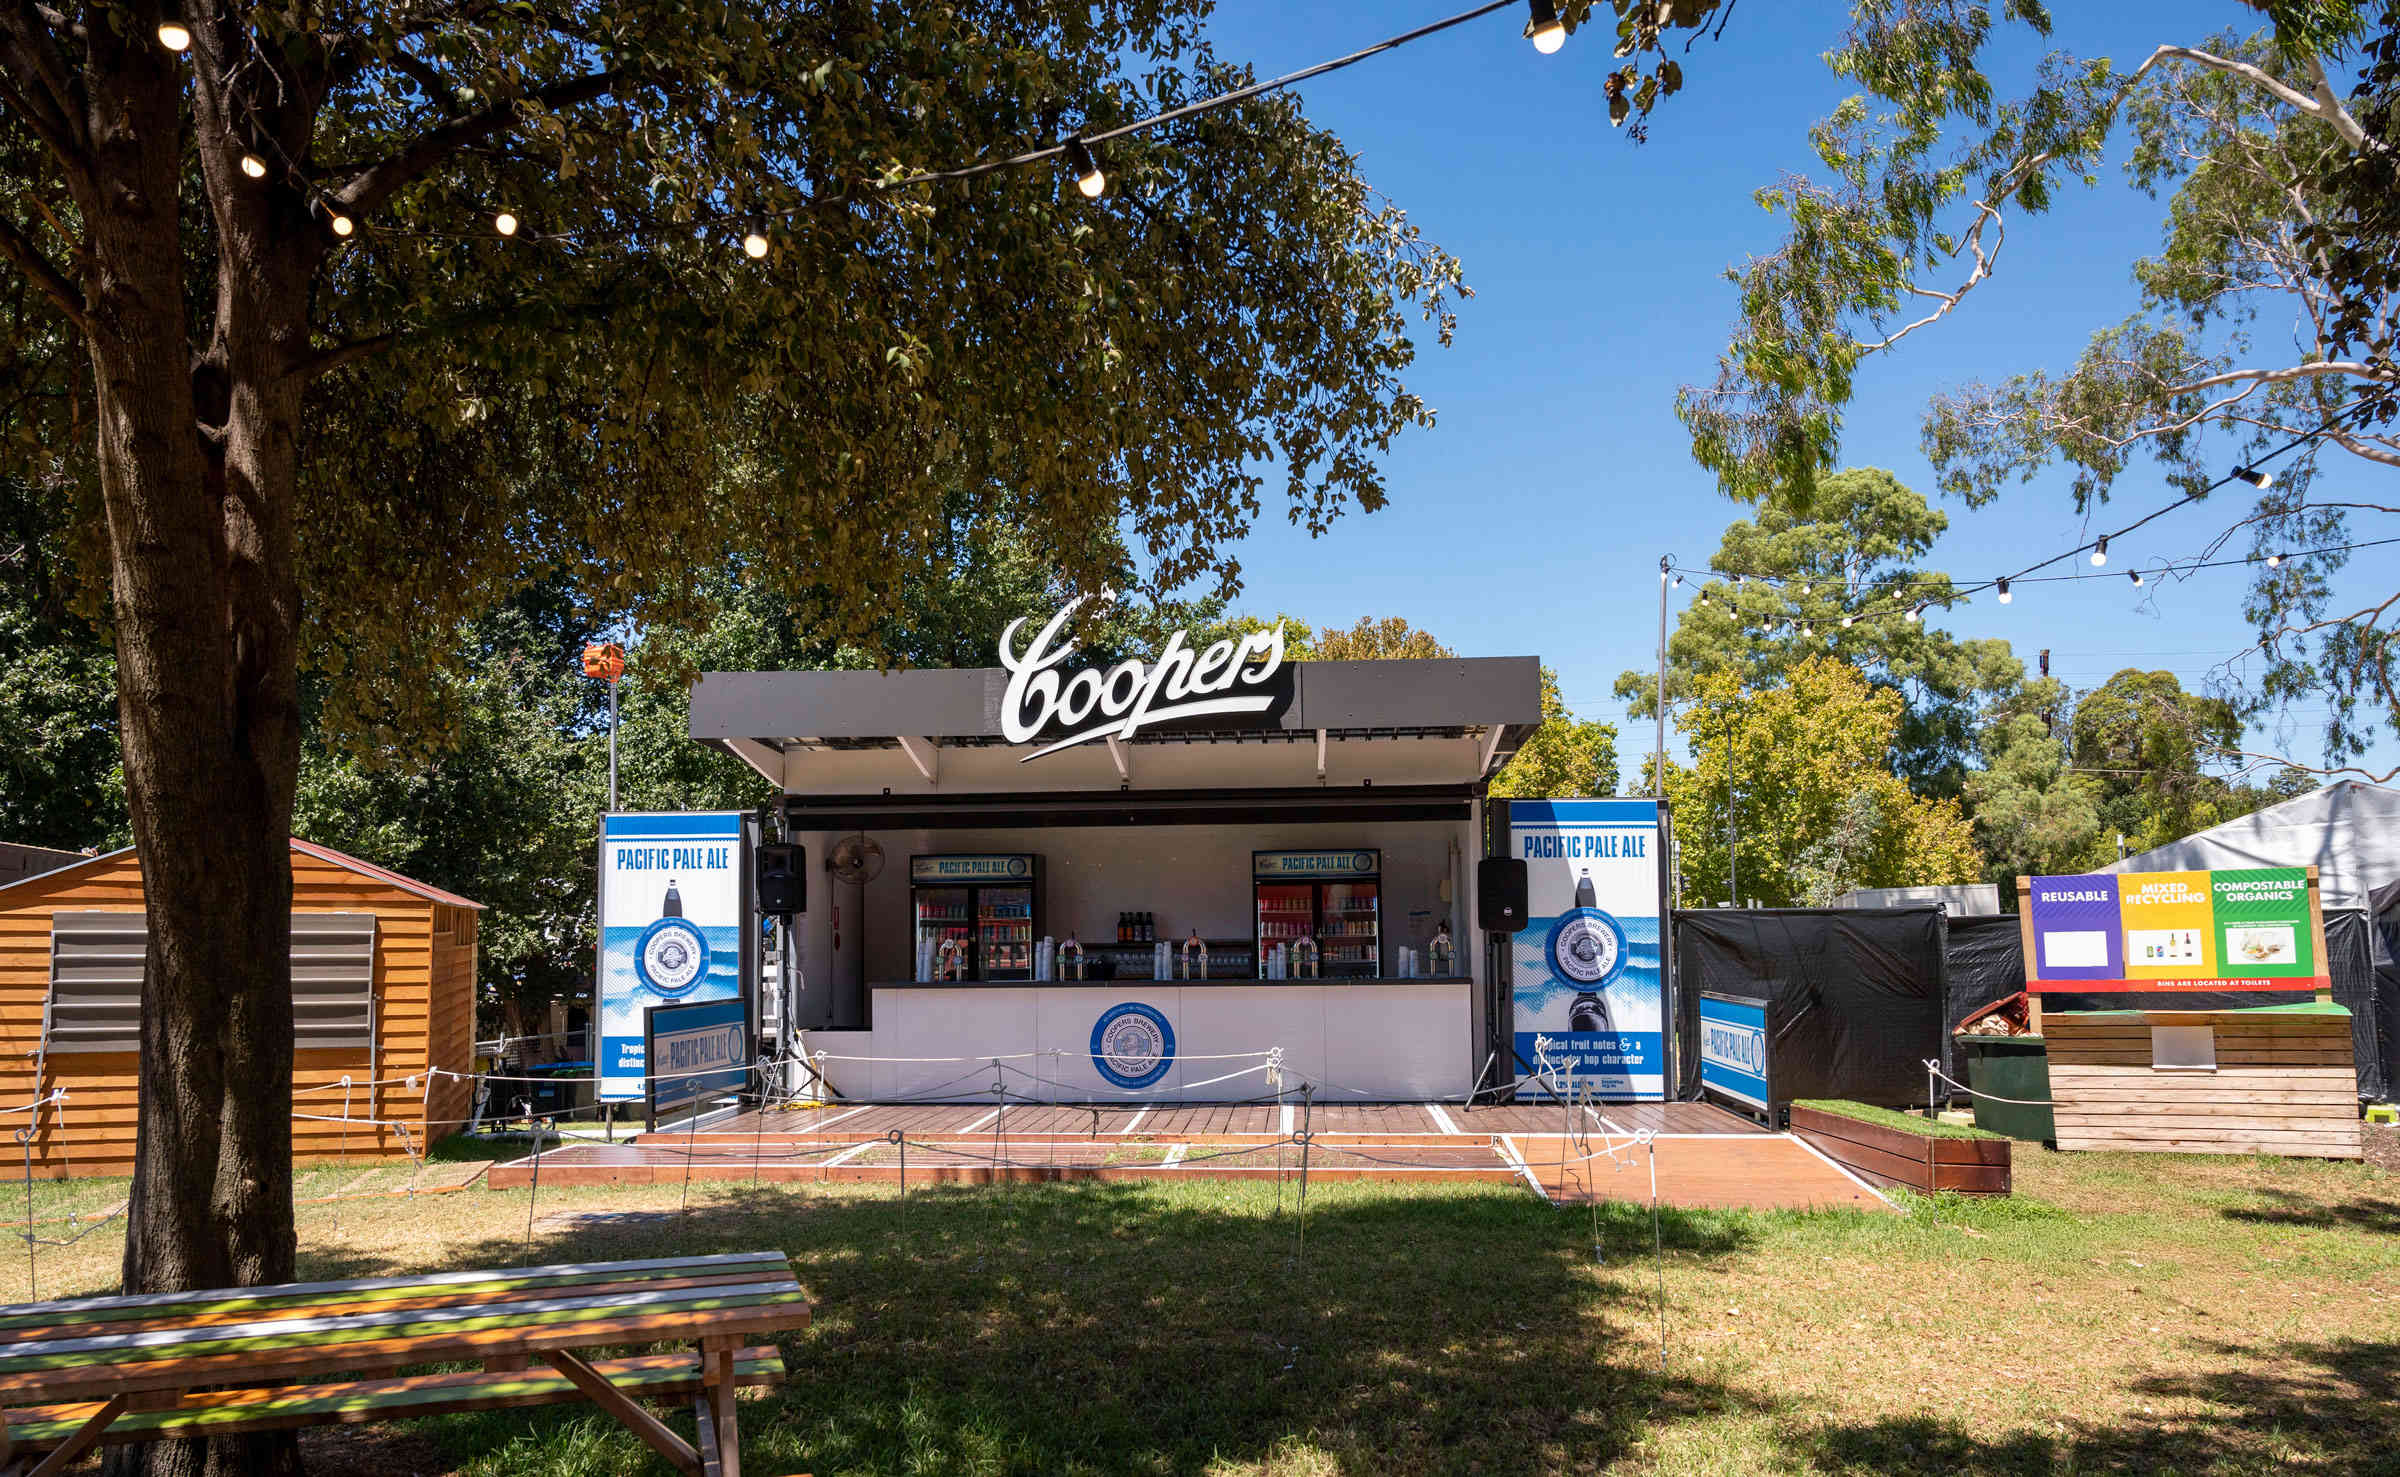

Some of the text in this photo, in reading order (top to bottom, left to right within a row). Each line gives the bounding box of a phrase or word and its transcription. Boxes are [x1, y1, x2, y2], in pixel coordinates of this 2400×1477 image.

[999, 588, 1286, 763] Coopers
[1524, 835, 1646, 858] PACIFIC PALE ALE
[617, 847, 729, 870] PACIFIC PALE ALE
[1282, 856, 1315, 871] PACIFIC
[1316, 856, 1335, 870] PALE
[1336, 855, 1350, 870] ALE
[939, 861, 971, 874] PACIFIC
[972, 861, 990, 873] PALE
[991, 861, 1006, 873] ALE
[2141, 883, 2188, 894] MIXED
[2213, 880, 2305, 892] COMPOSTABLE
[2041, 890, 2109, 903] REUSABLE
[2126, 892, 2206, 905] RECYCLING
[2226, 890, 2294, 902] ORGANICS
[1105, 1018, 1160, 1043] COOPERS BREWERY
[670, 1038, 699, 1070] PACIFIC
[699, 1034, 716, 1064] PALE
[716, 1031, 728, 1060] ALE
[1571, 1039, 1590, 1050] fruit
[1593, 1040, 1616, 1050] notes
[1619, 1037, 1632, 1052] &
[1635, 1040, 1641, 1050] a
[1711, 1027, 1729, 1058] PACIFIC
[1729, 1031, 1741, 1062] PALE
[1741, 1034, 1751, 1065] ALE
[1584, 1054, 1600, 1067] hop
[1602, 1053, 1644, 1065] character
[1130, 1064, 1150, 1073] PALE
